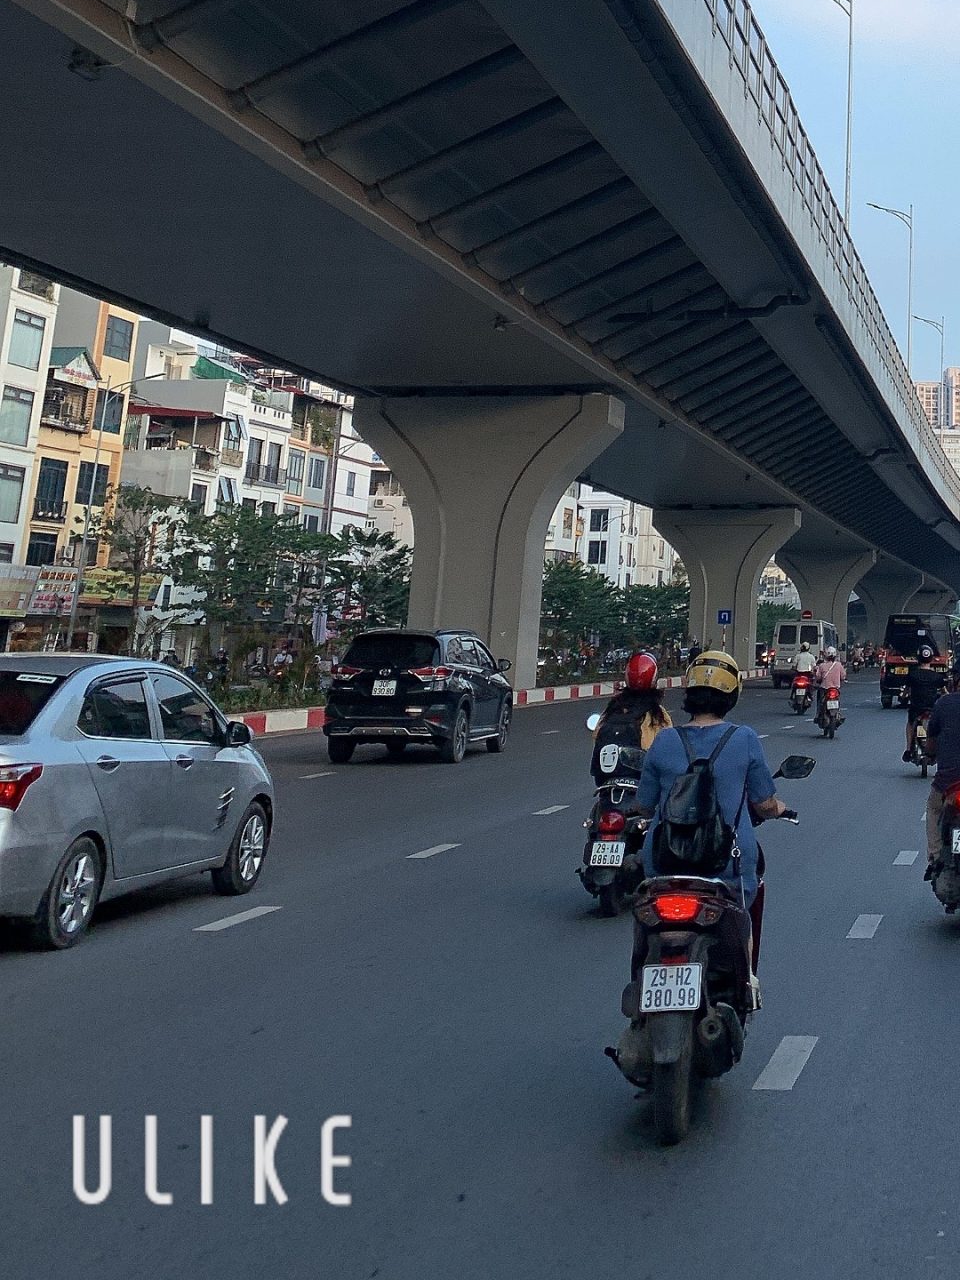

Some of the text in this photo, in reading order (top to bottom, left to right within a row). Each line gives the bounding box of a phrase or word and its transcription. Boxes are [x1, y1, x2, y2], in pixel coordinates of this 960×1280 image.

[596, 843, 619, 854] 29-AA
[650, 967, 692, 988] 29-H2
[644, 988, 696, 1009] 380.98
